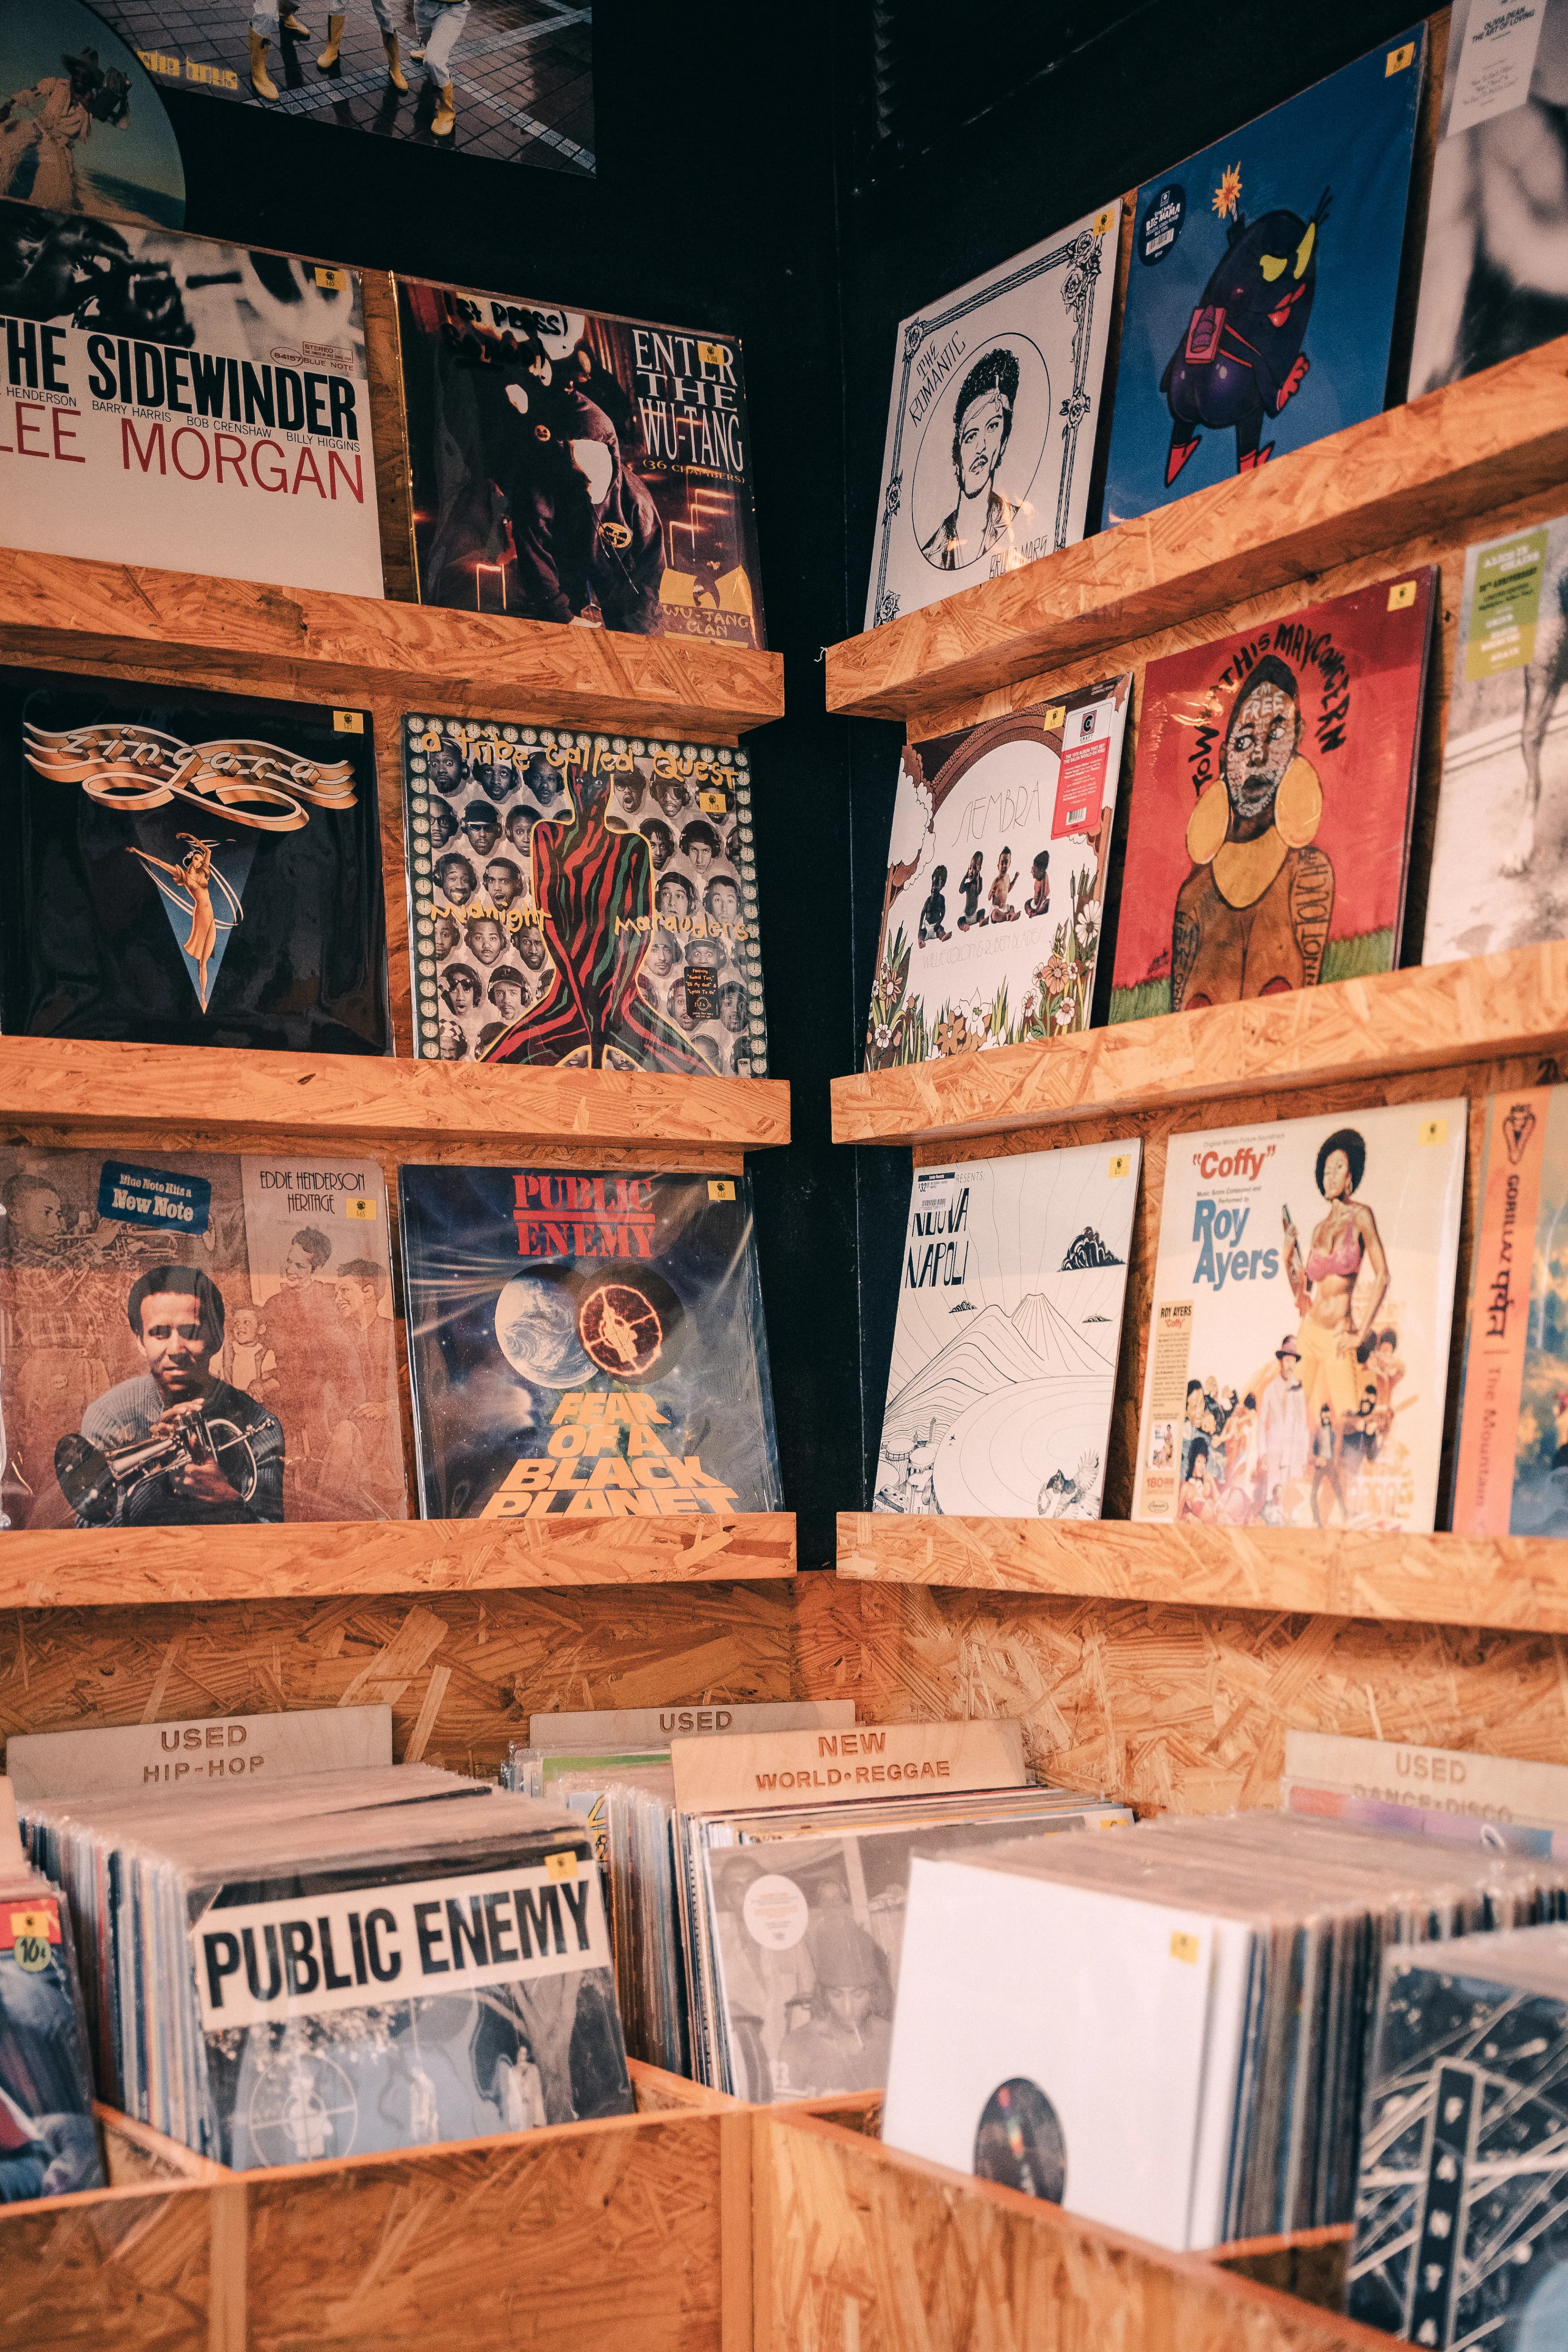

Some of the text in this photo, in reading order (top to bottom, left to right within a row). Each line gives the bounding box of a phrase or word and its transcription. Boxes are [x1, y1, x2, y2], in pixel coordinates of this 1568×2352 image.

[1146, 217, 1158, 232] BIG
[1158, 203, 1180, 222] MAMA
[274, 352, 301, 362] 84157
[303, 357, 354, 371] BLUE NOTE
[305, 344, 334, 354] STEREO
[915, 340, 940, 382] THE
[0, 317, 69, 394] HE
[87, 334, 359, 441] SIDEWINDER
[637, 370, 738, 412] THE
[909, 330, 966, 428] ROMANTIC
[7, 386, 360, 452] HENDERSON BARRY HARRIS BOB CRENSHAW BILLY HIGGINS
[638, 397, 744, 472] WU-TANG
[0, 401, 364, 504] EE MORGAN
[643, 459, 745, 484] (36 CHAMBERS)
[1020, 535, 1048, 565] MARS
[662, 605, 749, 628] WU-TANG
[686, 620, 728, 637] CLAN
[1219, 633, 1270, 686] THIS
[1274, 623, 1315, 672] MAY
[422, 731, 440, 752] a
[431, 901, 751, 941] Midnight Marauders
[119, 1174, 192, 1198] Blue Note Hits a
[260, 1171, 365, 1191] EDDIE HENDERSON
[513, 1175, 654, 1211] PUBLIC
[956, 1171, 985, 1183] RESENTS:
[111, 1188, 194, 1222] New Note
[287, 1194, 336, 1214] HERITAGE
[1192, 1199, 1251, 1247] Roy
[517, 1223, 655, 1258] ENEMY
[905, 1240, 969, 1288] NAPOLI
[1192, 1241, 1280, 1292] Ayers
[1160, 1306, 1192, 1318] ROY AYERS
[549, 1392, 672, 1424] FEAR
[547, 1423, 670, 1458] OF A
[499, 1456, 727, 1491] BLACK
[478, 1488, 740, 1519] PLANET
[659, 1711, 733, 1734] USED
[161, 1725, 247, 1753] USED
[818, 1732, 886, 1758] NEW
[143, 1755, 265, 1783] HIP-HOP
[1395, 1751, 1468, 1785] USED
[203, 1880, 590, 2009] PUBLIC ENEMY
